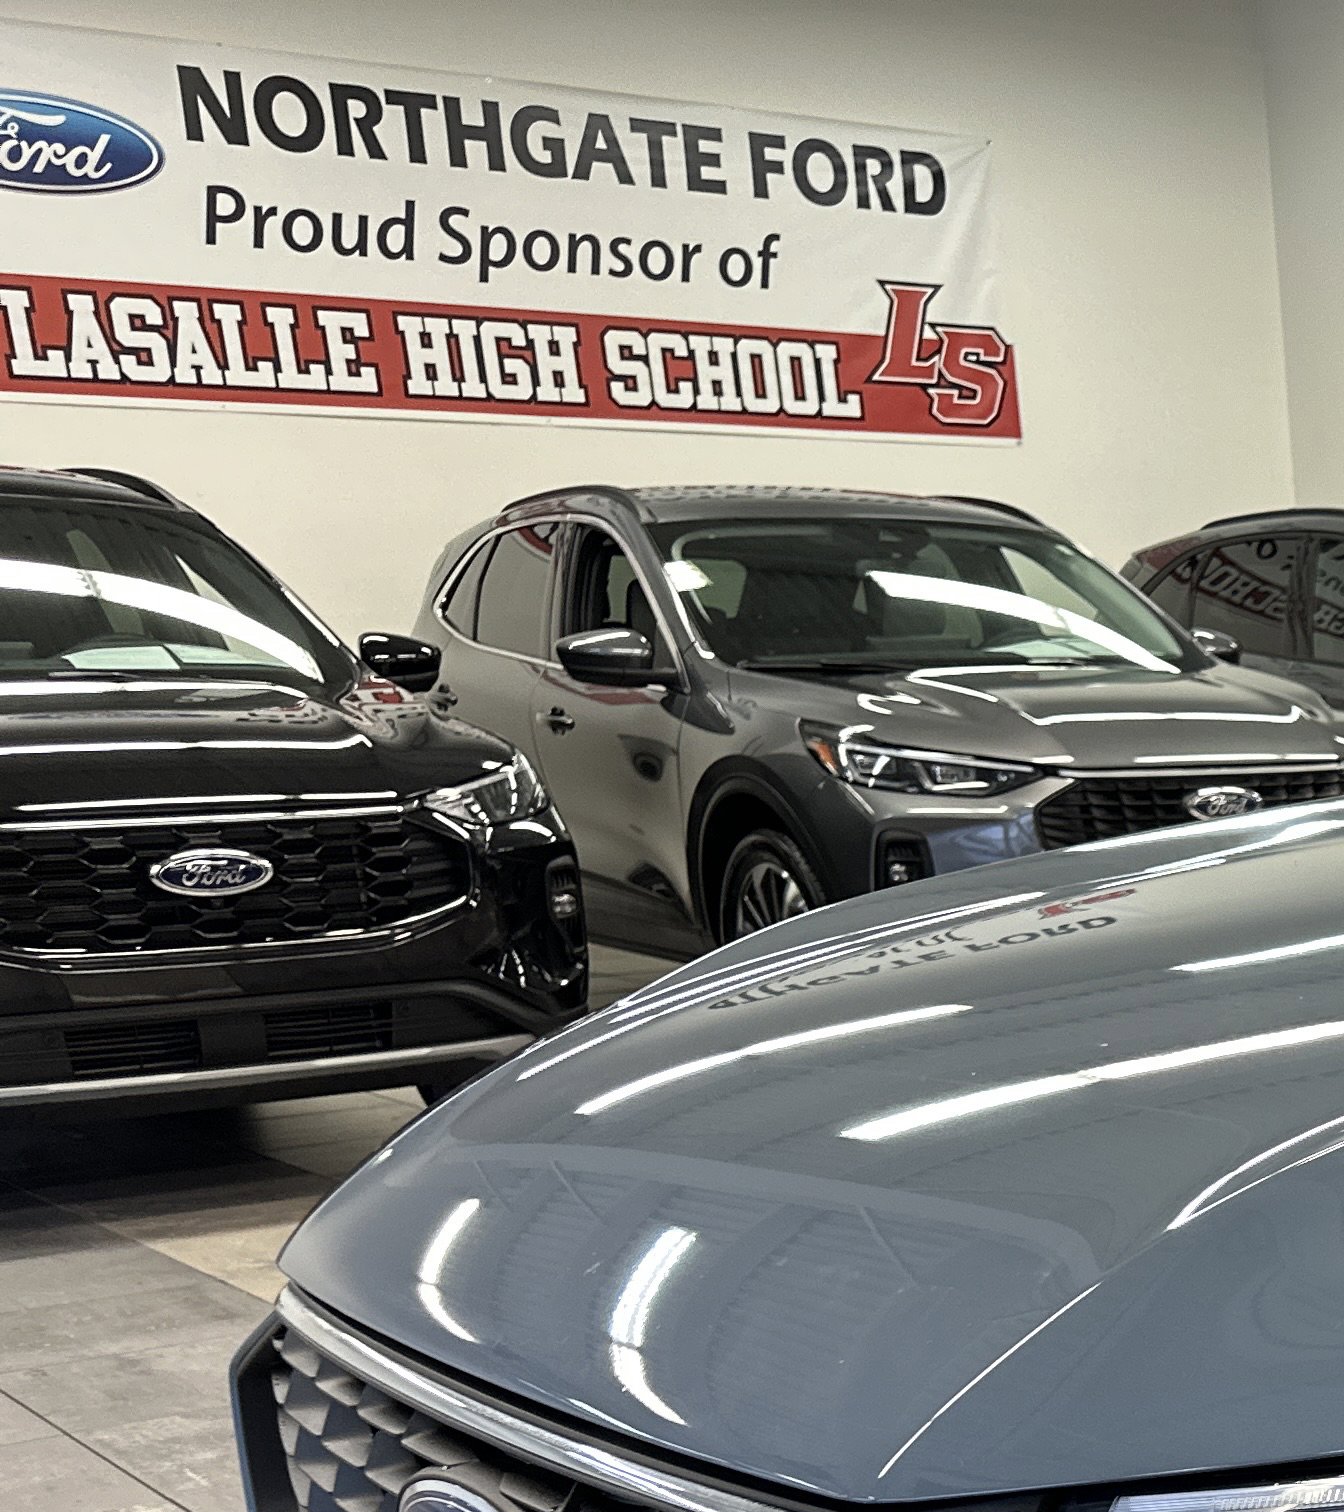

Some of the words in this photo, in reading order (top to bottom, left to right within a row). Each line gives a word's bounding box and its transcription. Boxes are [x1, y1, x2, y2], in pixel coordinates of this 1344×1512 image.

[175, 64, 729, 196] NORTHGATE
[749, 131, 947, 217] FORD
[203, 185, 416, 262] Proud
[438, 206, 704, 284] Sponsor
[718, 233, 780, 291] of
[0, 286, 382, 395] LASALLE
[396, 313, 590, 404] HIGH
[602, 327, 864, 421] SCHOOL
[181, 859, 247, 887] Ford
